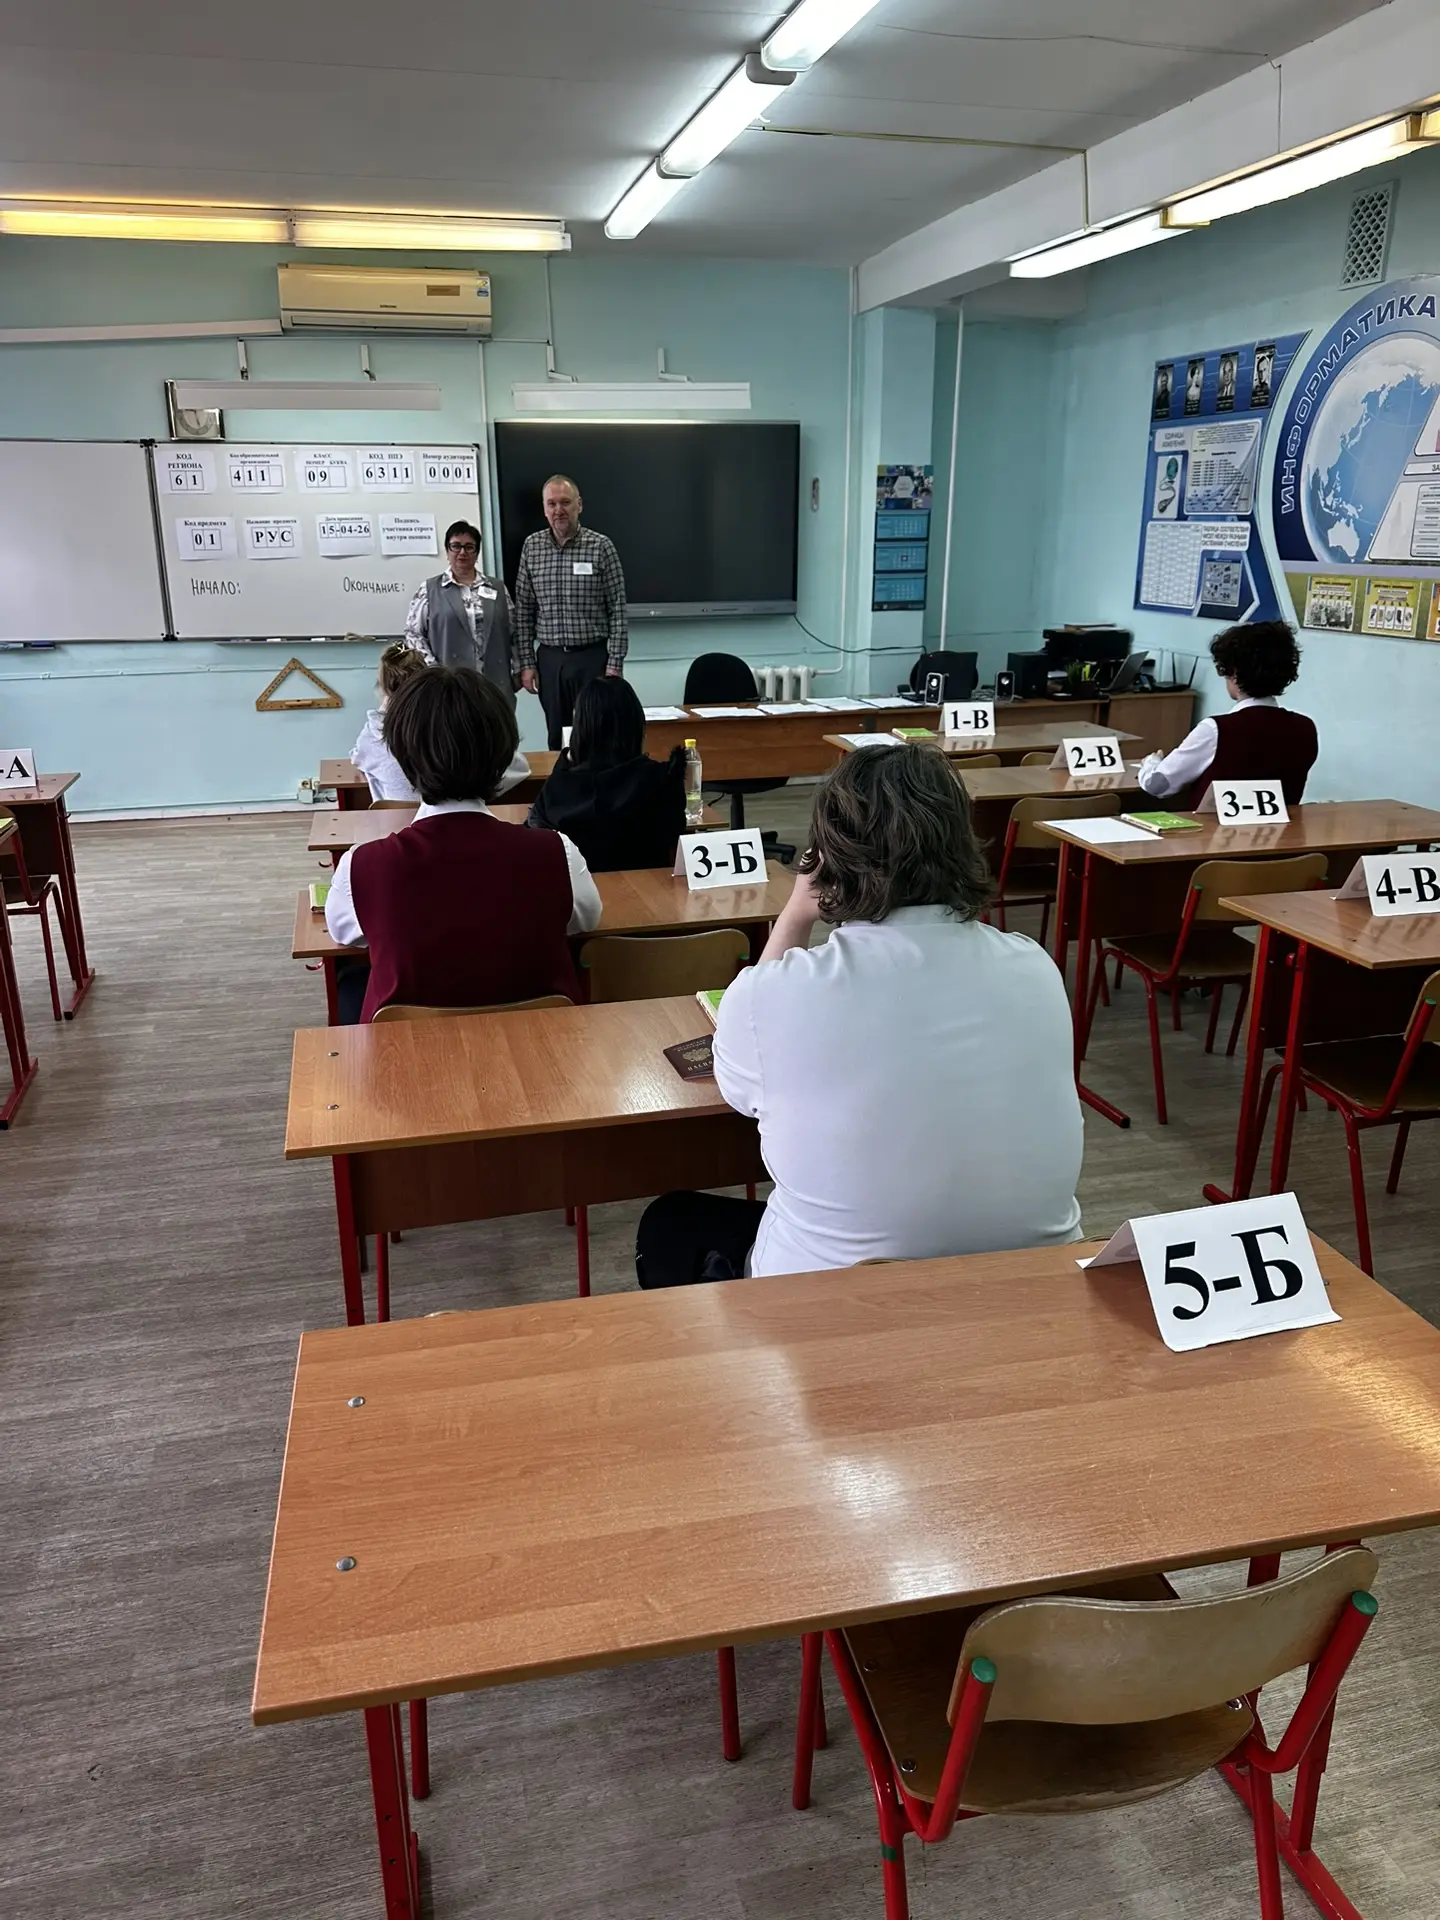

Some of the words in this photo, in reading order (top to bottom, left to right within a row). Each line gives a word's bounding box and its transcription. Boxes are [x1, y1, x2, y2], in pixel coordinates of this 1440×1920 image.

[1281, 294, 1437, 514] ИНФОРМАТИКА
[255, 530, 292, 543] РУС
[321, 524, 370, 535] 15-04-26
[951, 709, 989, 730] 1-В
[1071, 745, 1117, 768] 2-В
[1221, 789, 1280, 817] 3-В
[691, 841, 758, 879] 3-Б
[1376, 867, 1440, 904] 4-В
[1164, 1224, 1304, 1320] 5-Б
